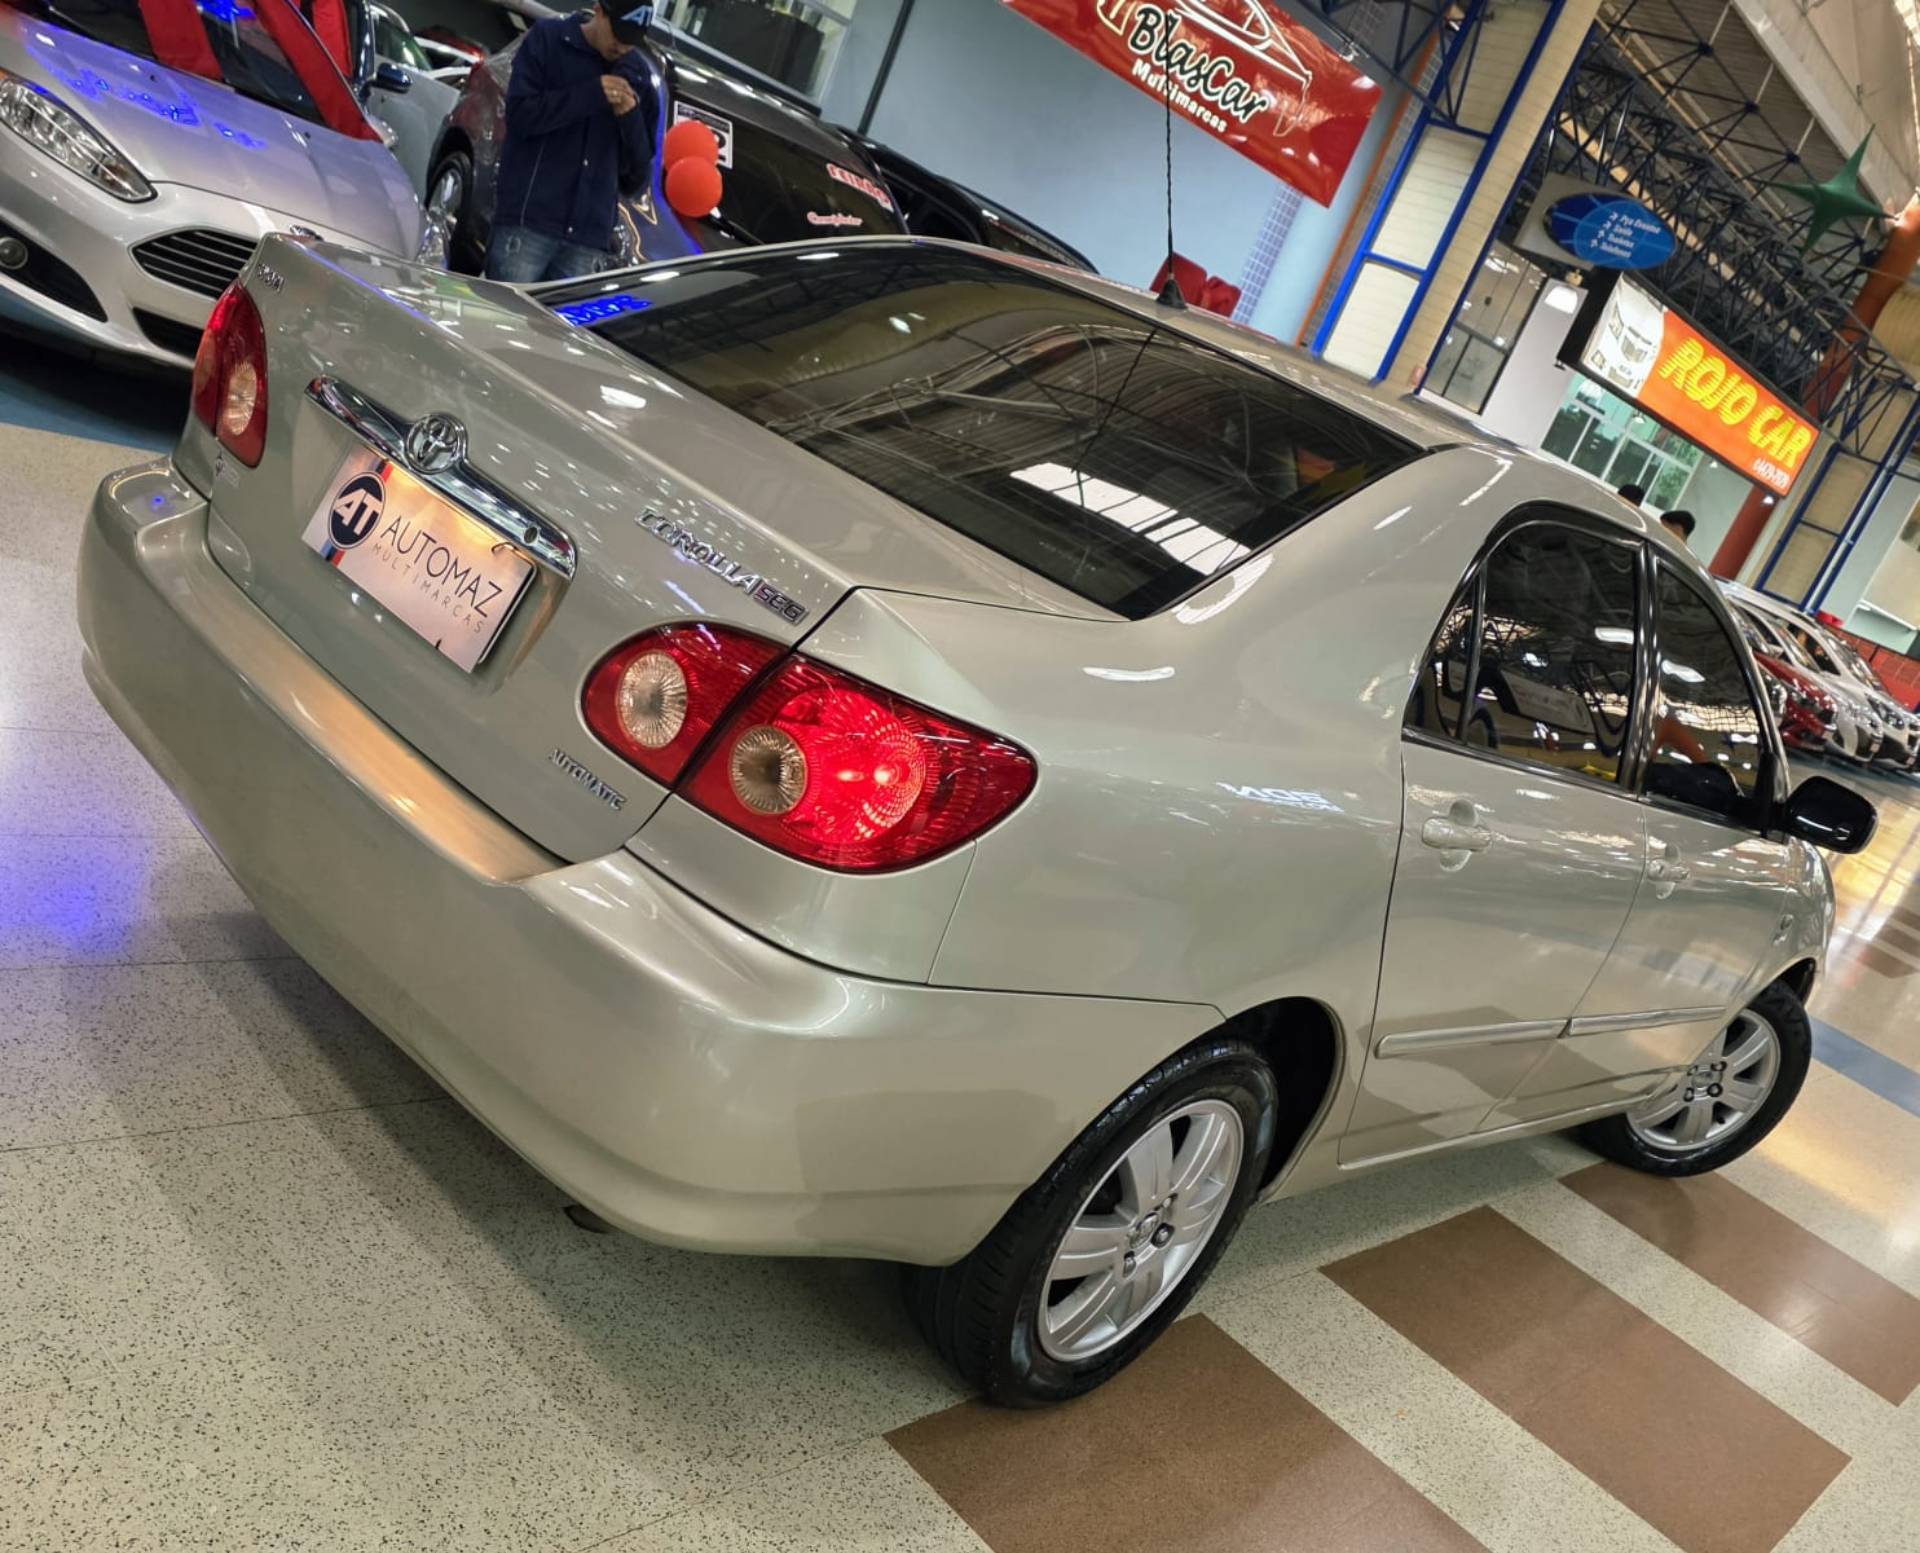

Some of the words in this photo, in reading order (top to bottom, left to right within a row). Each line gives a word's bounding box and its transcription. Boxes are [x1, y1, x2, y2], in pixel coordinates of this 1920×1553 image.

[1129, 5, 1272, 123] BlasCar
[1658, 337, 1759, 426] ROJO
[1747, 404, 1812, 469] CAR
[371, 543, 489, 634] MULTIMARCAS
[379, 514, 503, 618] AUTOMAZ
[635, 508, 763, 596] COROLLA
[753, 580, 810, 627] SEG
[548, 748, 627, 811] AUTOMATIC
